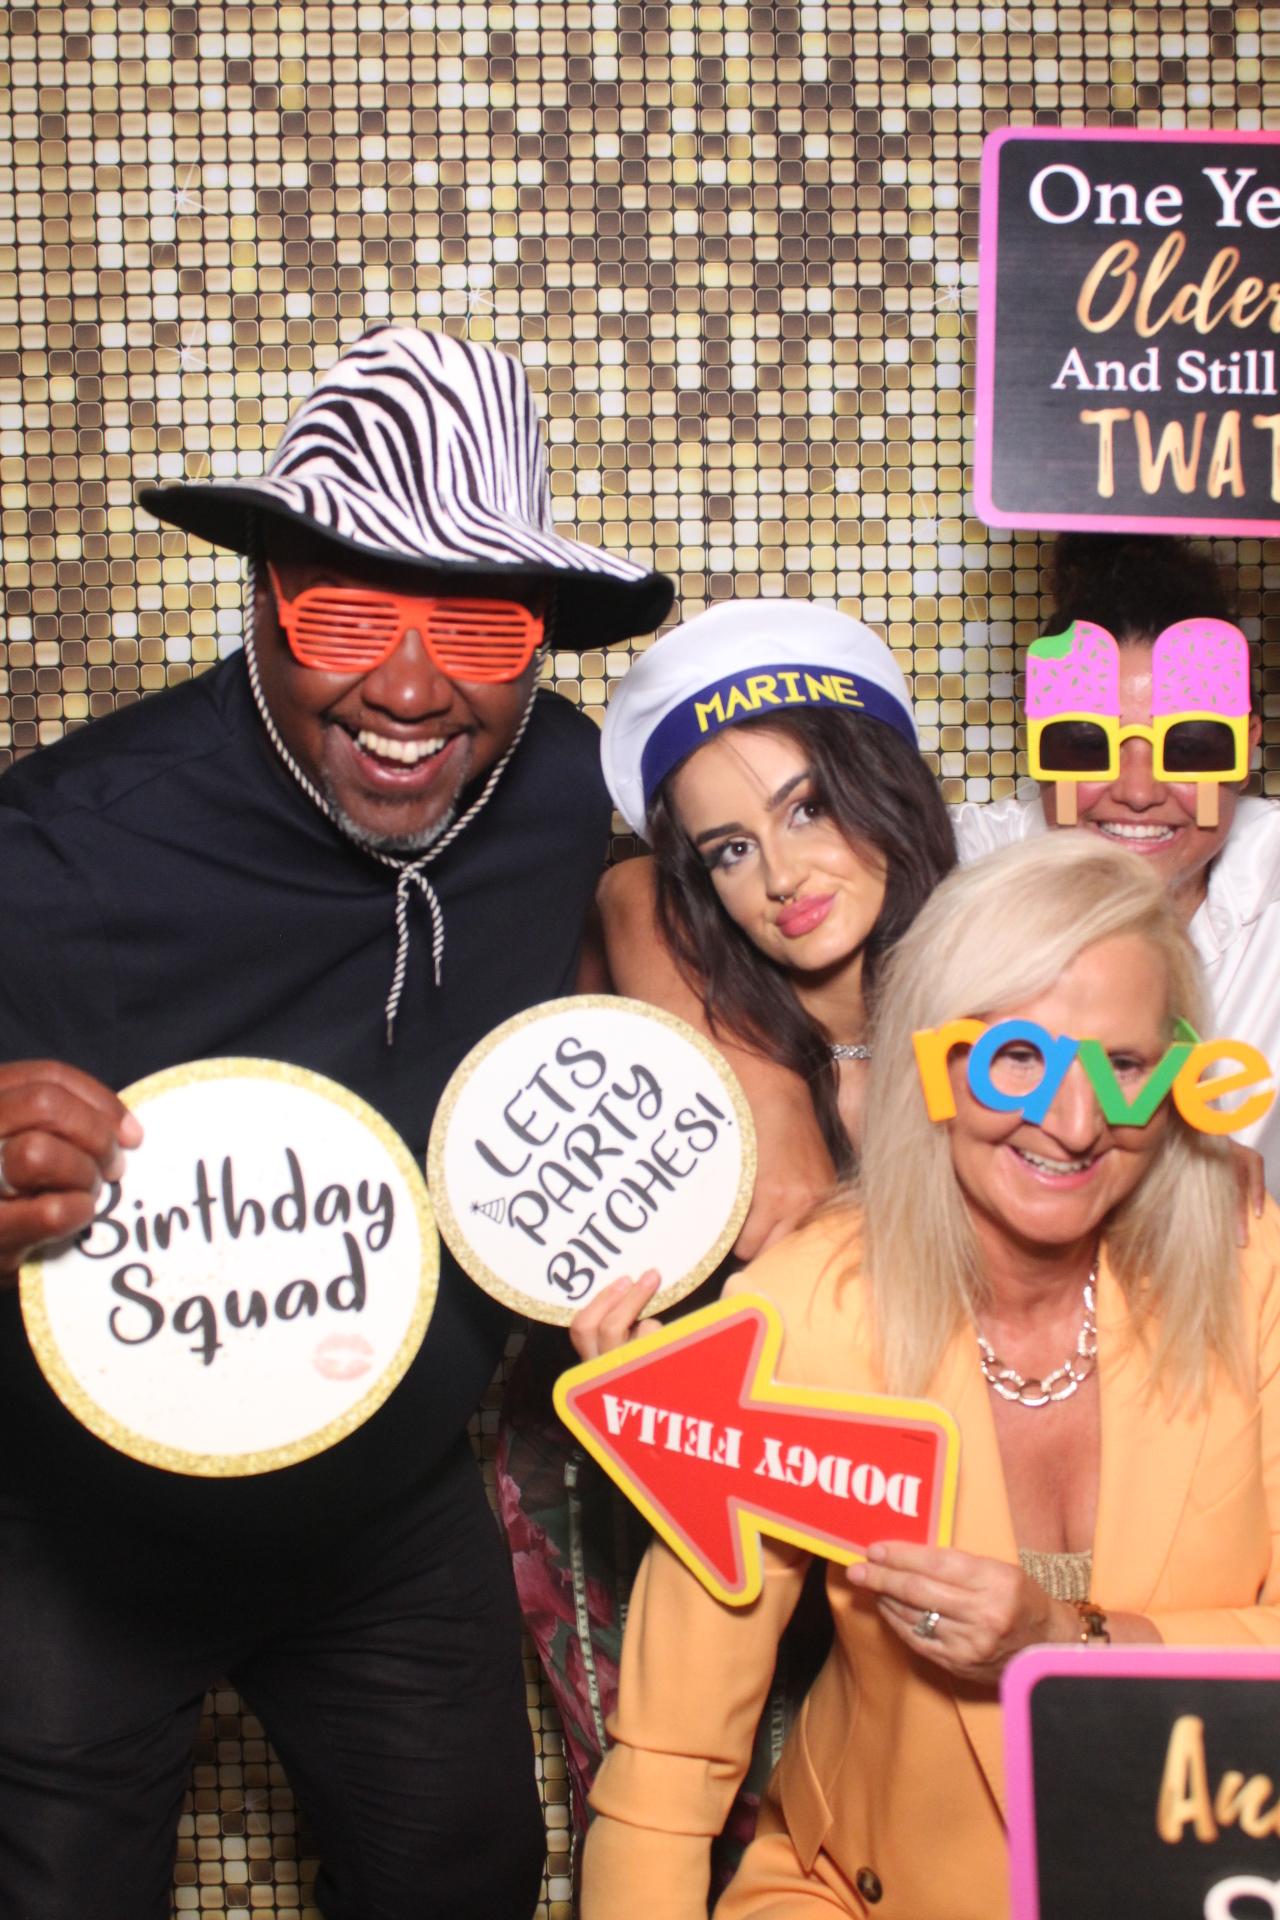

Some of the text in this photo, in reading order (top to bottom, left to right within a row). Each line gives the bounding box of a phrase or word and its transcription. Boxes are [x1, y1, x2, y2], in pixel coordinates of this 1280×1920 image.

[1028, 163, 1184, 226] One
[1050, 347, 1277, 396] And Still
[694, 672, 864, 733] MARINE
[475, 1037, 607, 1178] LETS
[912, 1018, 1277, 1136] rave
[547, 1092, 733, 1301] BITCHES!
[109, 1231, 367, 1366] Squad
[601, 1393, 922, 1518] DODGY FELLA
[1156, 1714, 1280, 1845] An
